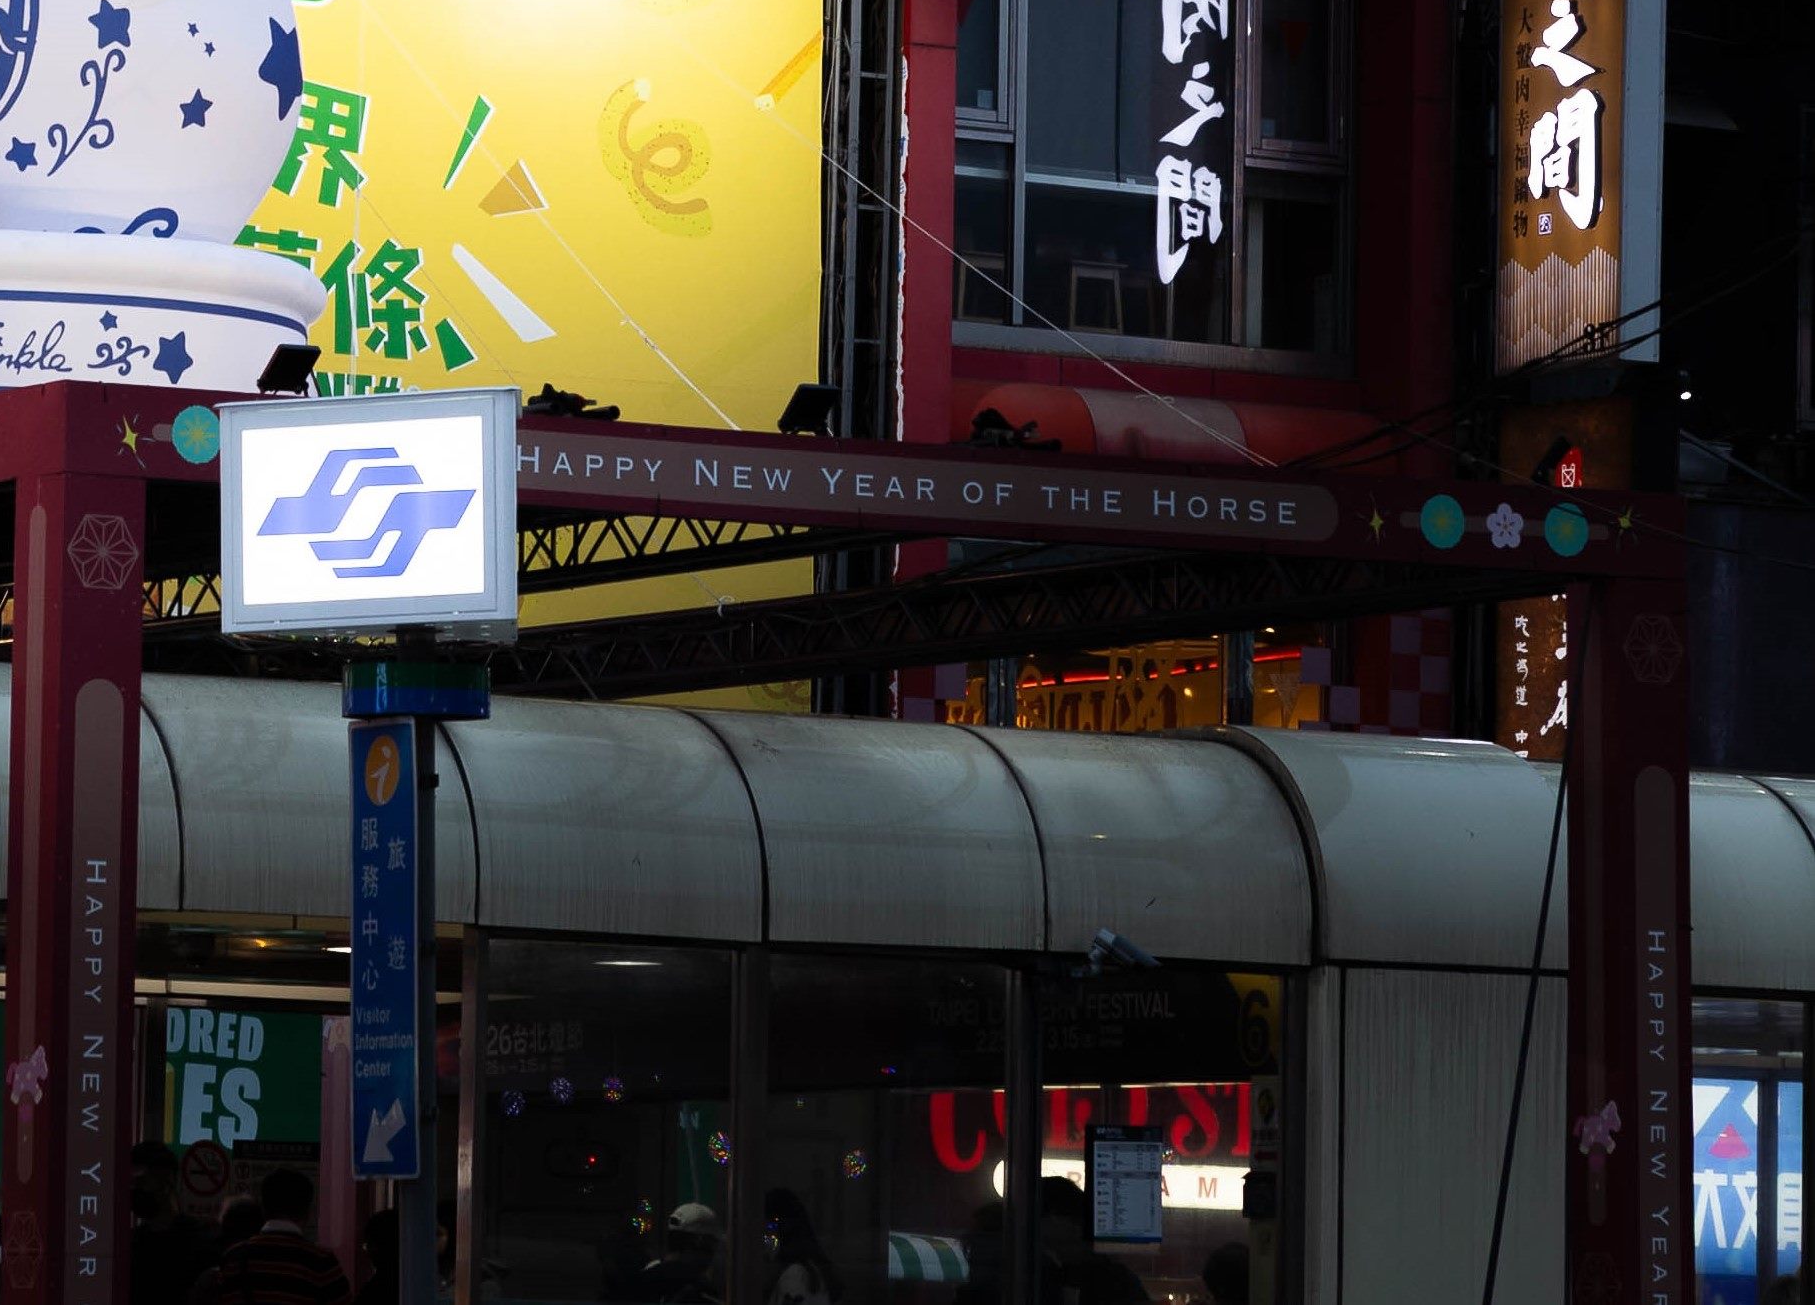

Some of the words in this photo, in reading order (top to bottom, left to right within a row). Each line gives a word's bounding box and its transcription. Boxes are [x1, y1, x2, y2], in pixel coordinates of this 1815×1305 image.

[515, 444, 663, 484] HAPPY
[694, 457, 792, 493] NEW
[820, 466, 936, 503] YEAR
[961, 480, 1013, 507] OF
[1040, 482, 1123, 514] THE
[1152, 489, 1299, 526] HORSE
[82, 858, 108, 1006] HAPPY
[360, 816, 380, 991] 服務中心
[386, 835, 407, 972] 旅遊
[354, 1031, 414, 1051] Information
[355, 1006, 392, 1025] Visitor
[1646, 929, 1667, 1063] HAPPY
[80, 1035, 105, 1135] NEW
[354, 1059, 392, 1078] Center
[1649, 1090, 1669, 1181] NEW
[78, 1161, 103, 1279] YEAR
